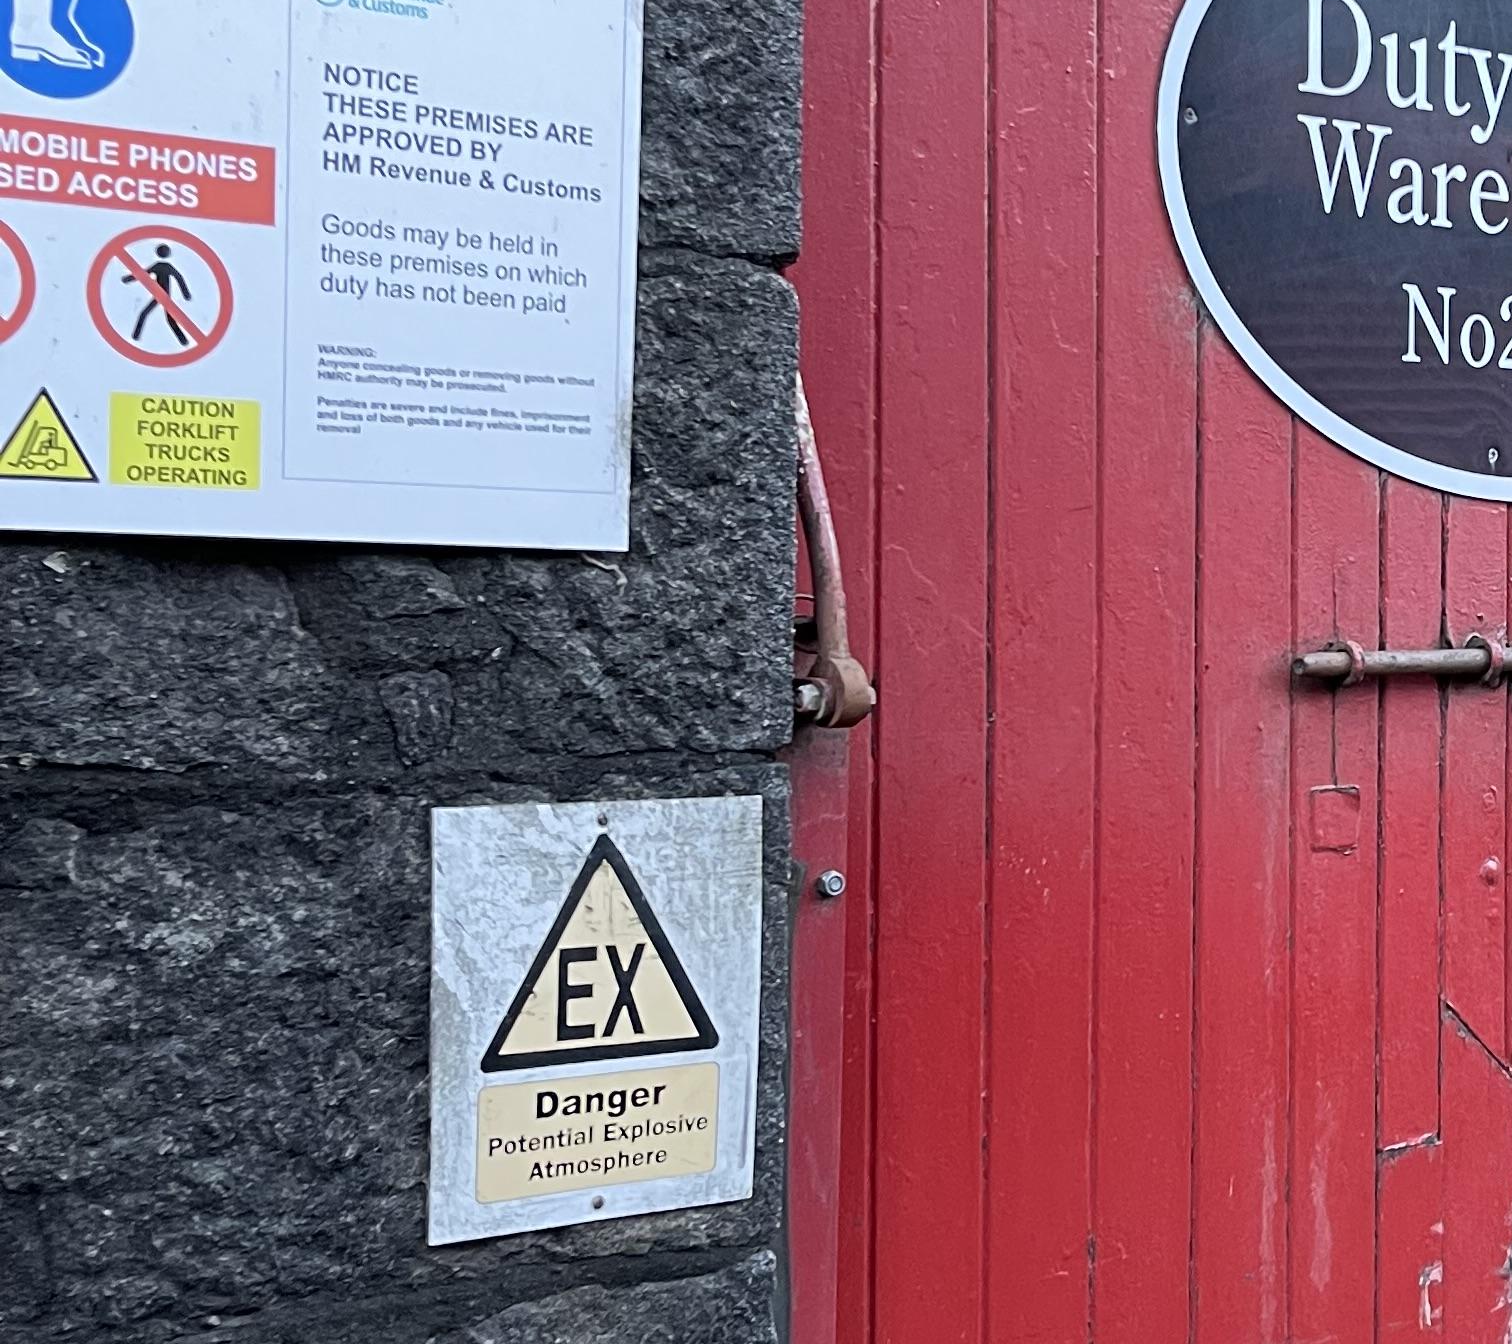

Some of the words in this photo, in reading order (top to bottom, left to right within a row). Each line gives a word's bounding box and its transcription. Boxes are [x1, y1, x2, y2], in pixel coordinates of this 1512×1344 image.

[324, 62, 419, 95] NOTICE
[323, 91, 407, 122] THESE
[415, 104, 538, 139] PREMISES
[545, 122, 593, 147] ARE
[0, 127, 120, 166] MOBILE
[128, 143, 258, 182] PHONES
[323, 121, 462, 157] APPROVED
[471, 140, 503, 162] BY
[67, 171, 199, 209] ACCESS
[323, 150, 361, 175] HM
[370, 156, 472, 187] Revenue
[479, 170, 495, 190] &
[503, 172, 601, 203] Customs
[321, 213, 395, 240] Goods
[403, 226, 448, 250] may
[456, 228, 482, 249] be
[489, 231, 533, 255] held
[541, 236, 558, 257] in
[321, 243, 382, 267] these
[390, 253, 488, 278] premises
[495, 264, 521, 282] on
[528, 265, 587, 288] which
[320, 272, 368, 300] duty
[376, 277, 415, 300] has
[423, 284, 456, 303] not
[463, 284, 516, 309] been
[522, 293, 566, 314] paid
[141, 397, 235, 418] CAUTION
[137, 419, 239, 440] FORKLIFT
[144, 443, 230, 463] TRUCKS
[126, 465, 247, 486] OPERATING
[557, 942, 647, 1041] EX
[535, 1084, 667, 1119] Danger
[488, 1126, 594, 1157] Potential
[603, 1113, 709, 1145] Explosive
[528, 1147, 668, 1183] Atmosphere
